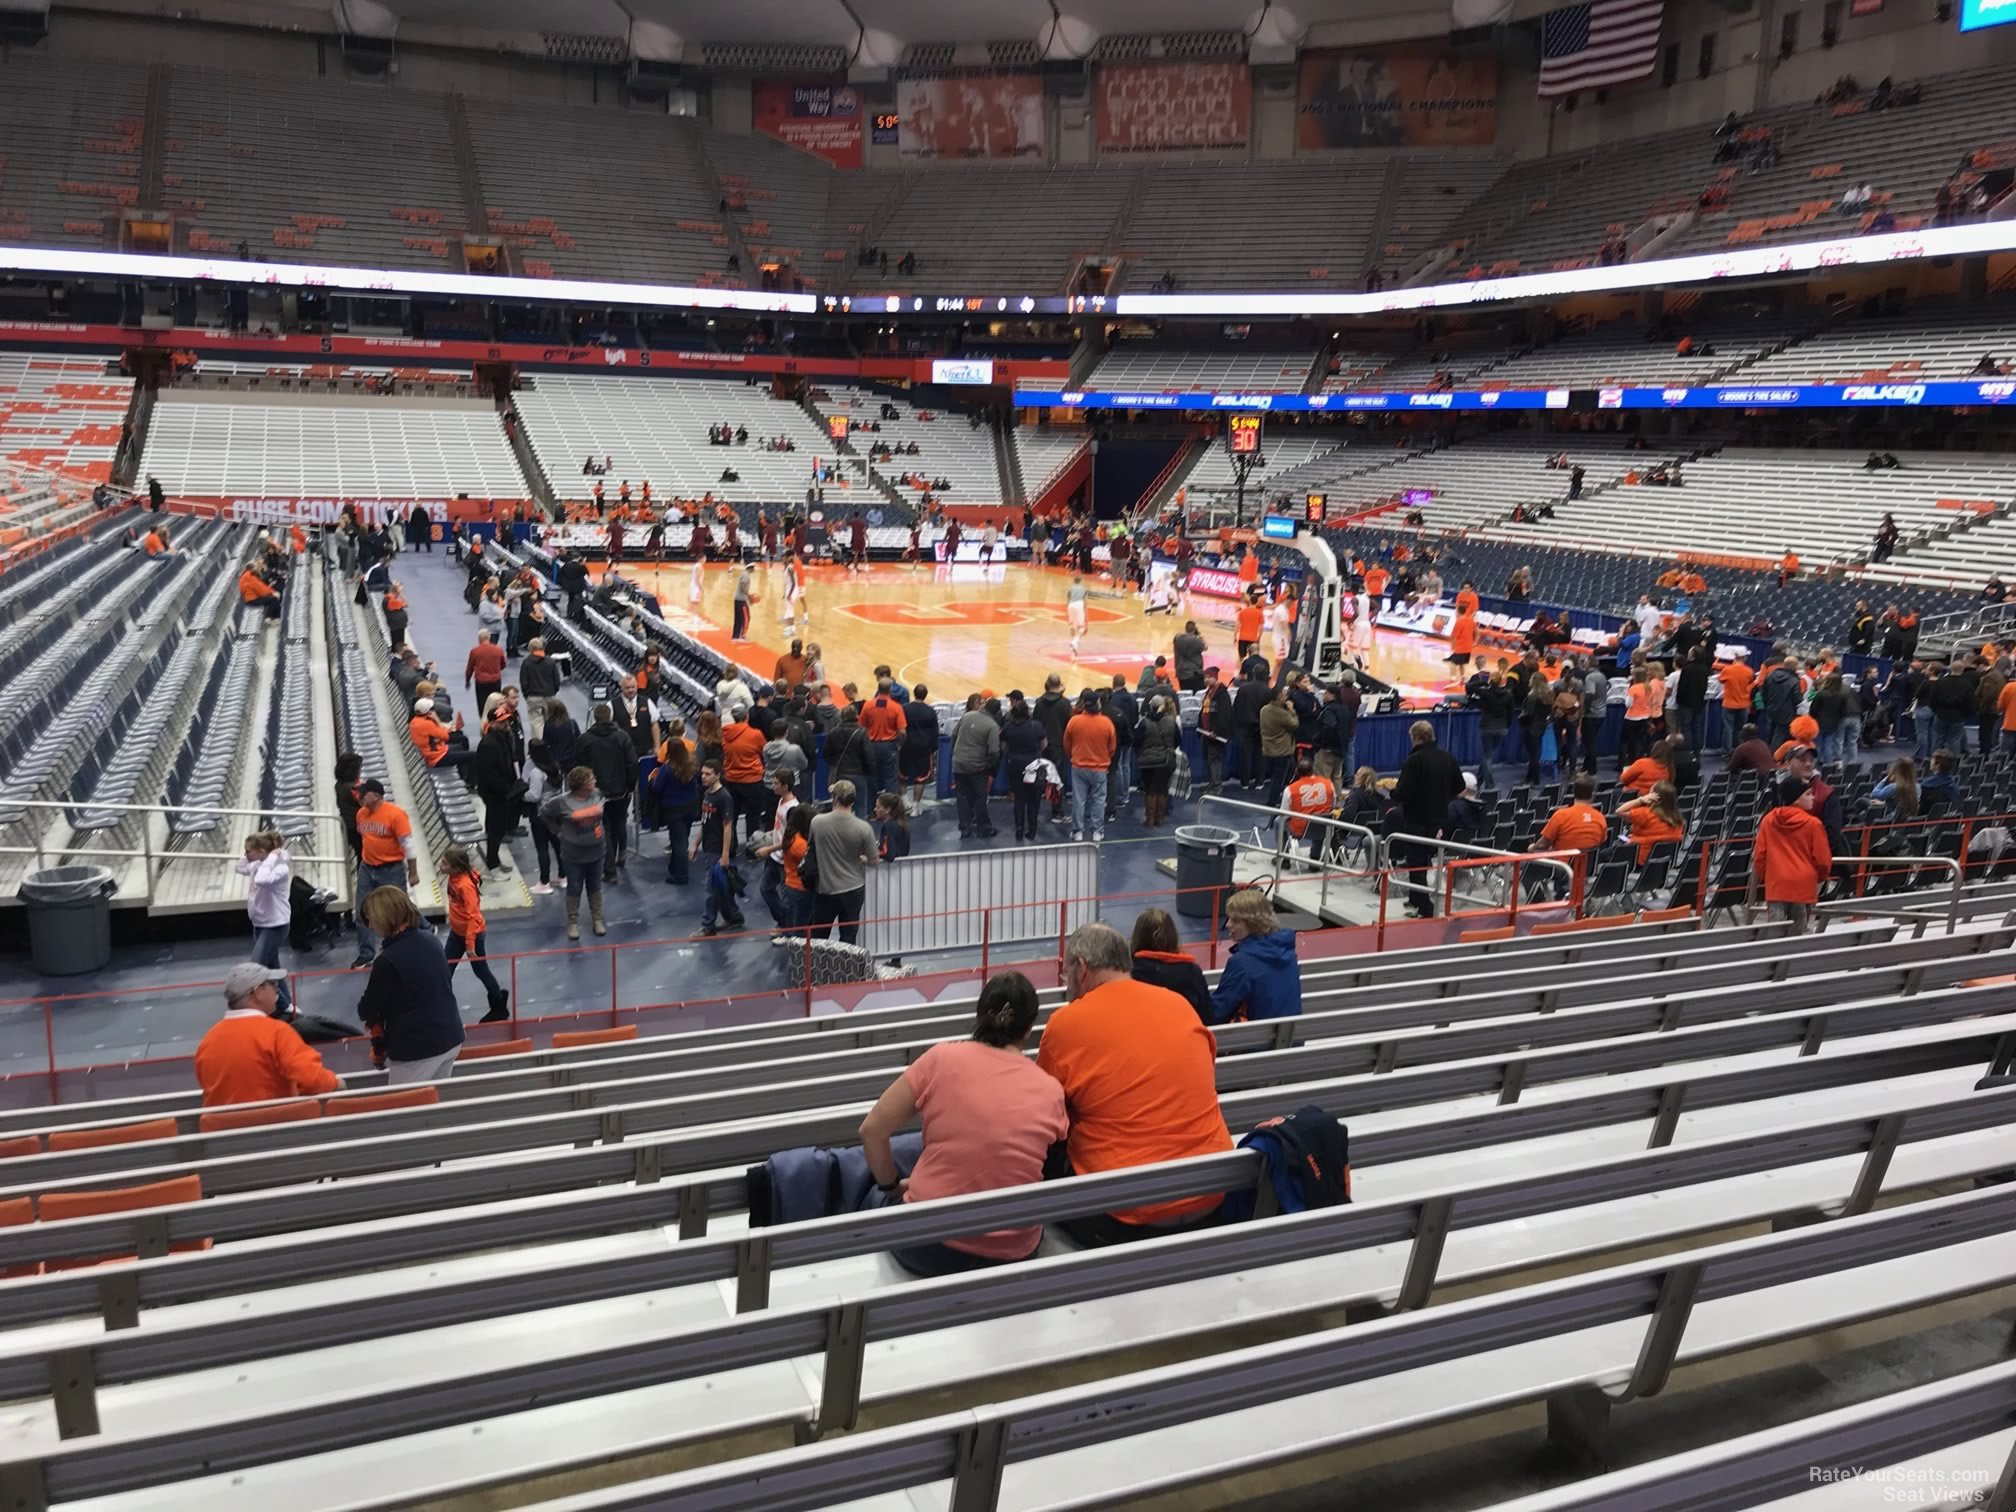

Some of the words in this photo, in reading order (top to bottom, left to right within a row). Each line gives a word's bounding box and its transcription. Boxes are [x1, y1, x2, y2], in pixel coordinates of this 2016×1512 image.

[795, 87, 830, 102] United
[808, 101, 830, 116] Way
[1338, 101, 1404, 113] NATIONAL
[1409, 98, 1495, 112] CHAMPIONS
[966, 298, 983, 310] 1ST
[1842, 385, 1926, 401] FALKEN
[1231, 417, 1260, 430] 51:44
[1233, 431, 1257, 451] 30
[1299, 782, 1328, 807] 23
